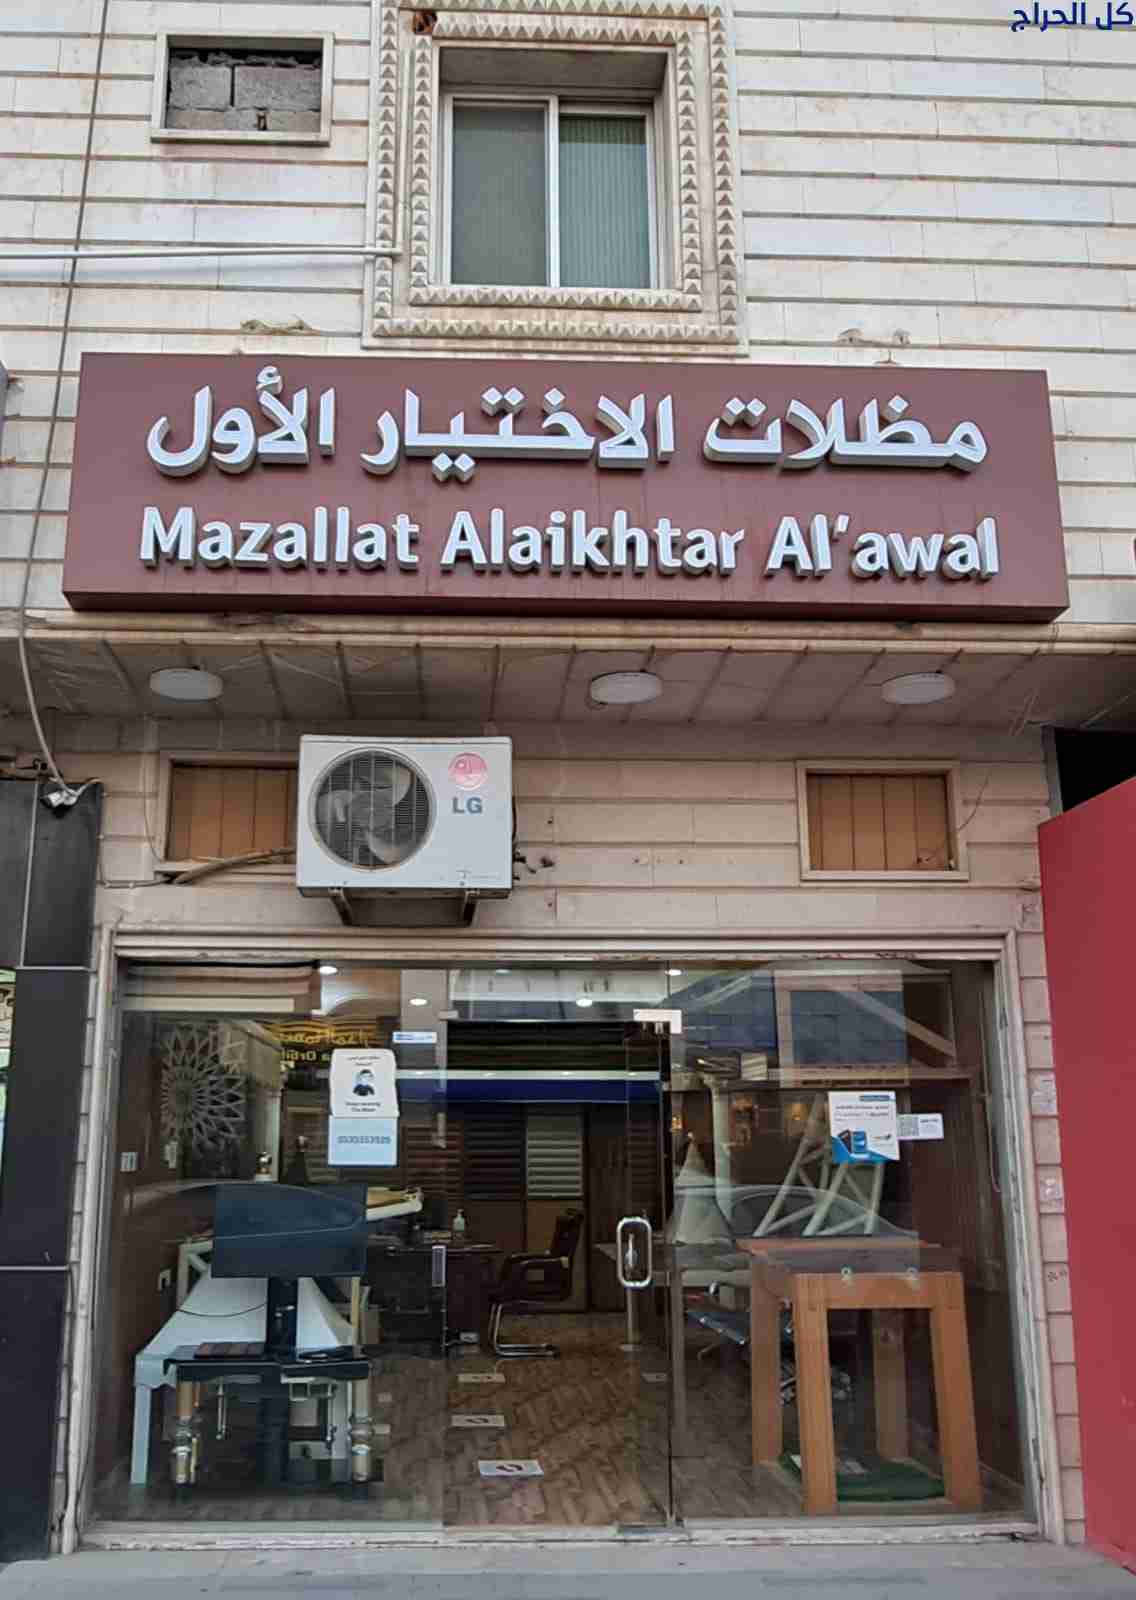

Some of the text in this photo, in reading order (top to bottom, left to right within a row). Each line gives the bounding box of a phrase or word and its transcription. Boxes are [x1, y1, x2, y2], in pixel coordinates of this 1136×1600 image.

[146, 365, 988, 481] مظلات الاختيار الأول
[139, 506, 999, 578] Mazallat Alaikhtar Al'awal
[452, 797, 483, 815] LG
